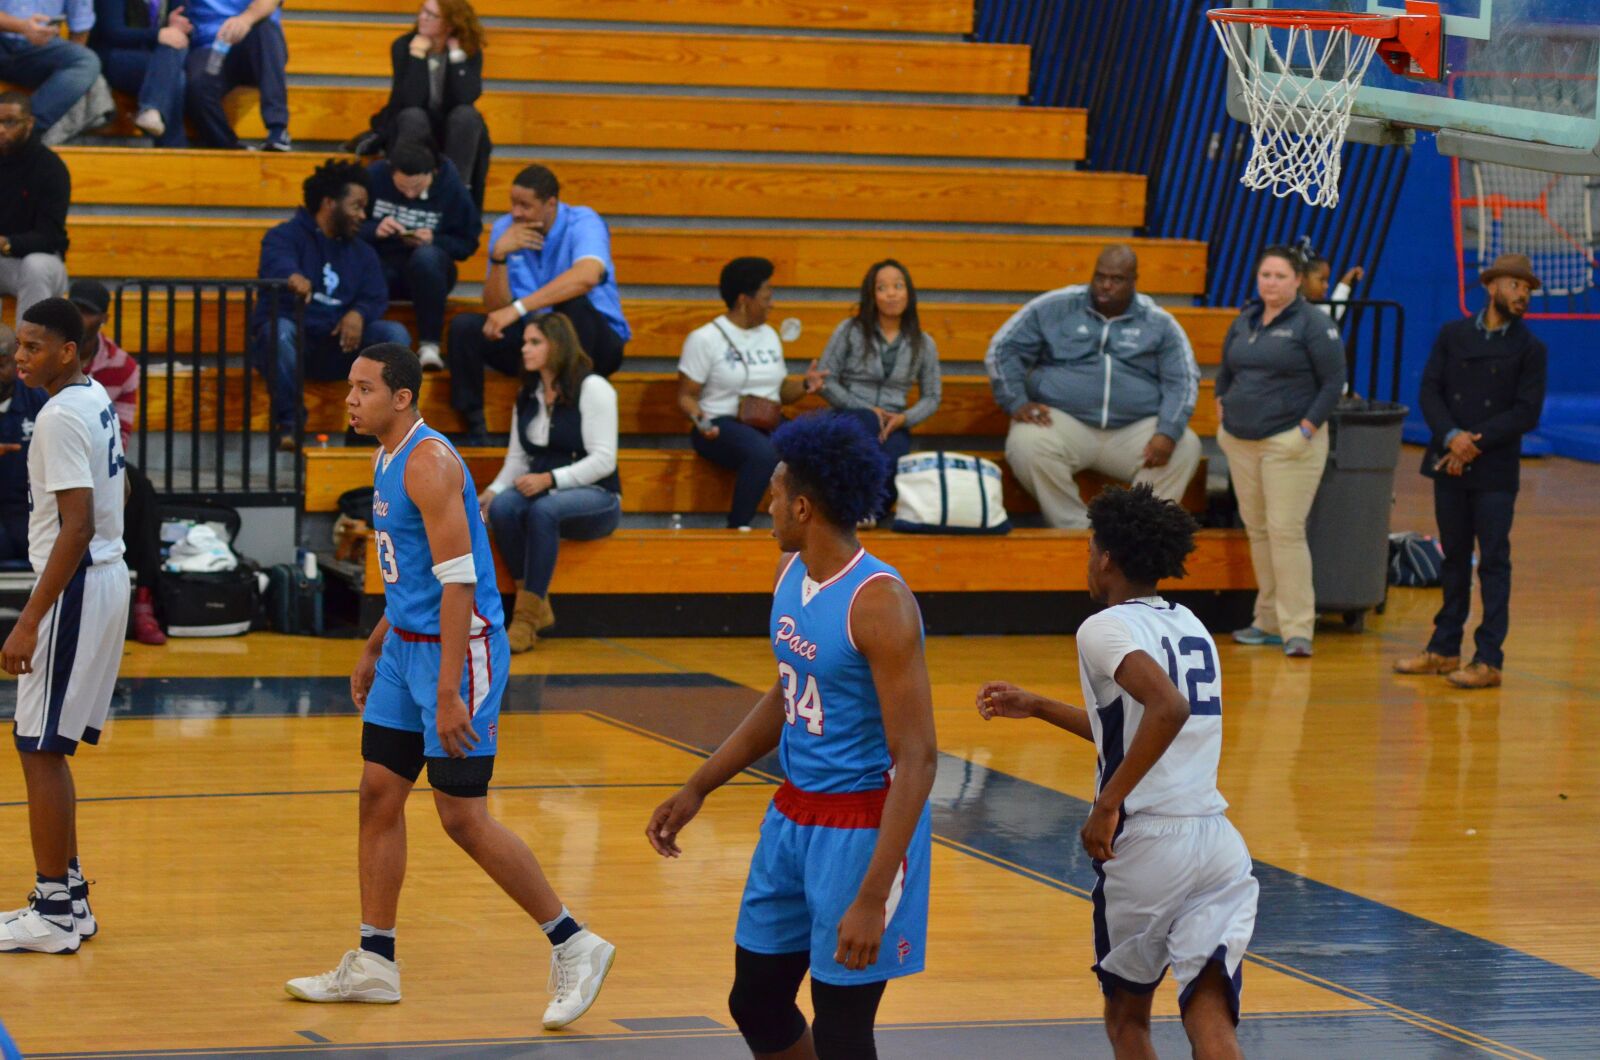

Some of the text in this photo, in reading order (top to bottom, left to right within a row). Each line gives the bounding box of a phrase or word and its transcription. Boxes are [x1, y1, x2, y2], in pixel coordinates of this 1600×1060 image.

[775, 614, 817, 661] Pace
[1160, 635, 1222, 716] 12
[778, 659, 825, 737] 34
